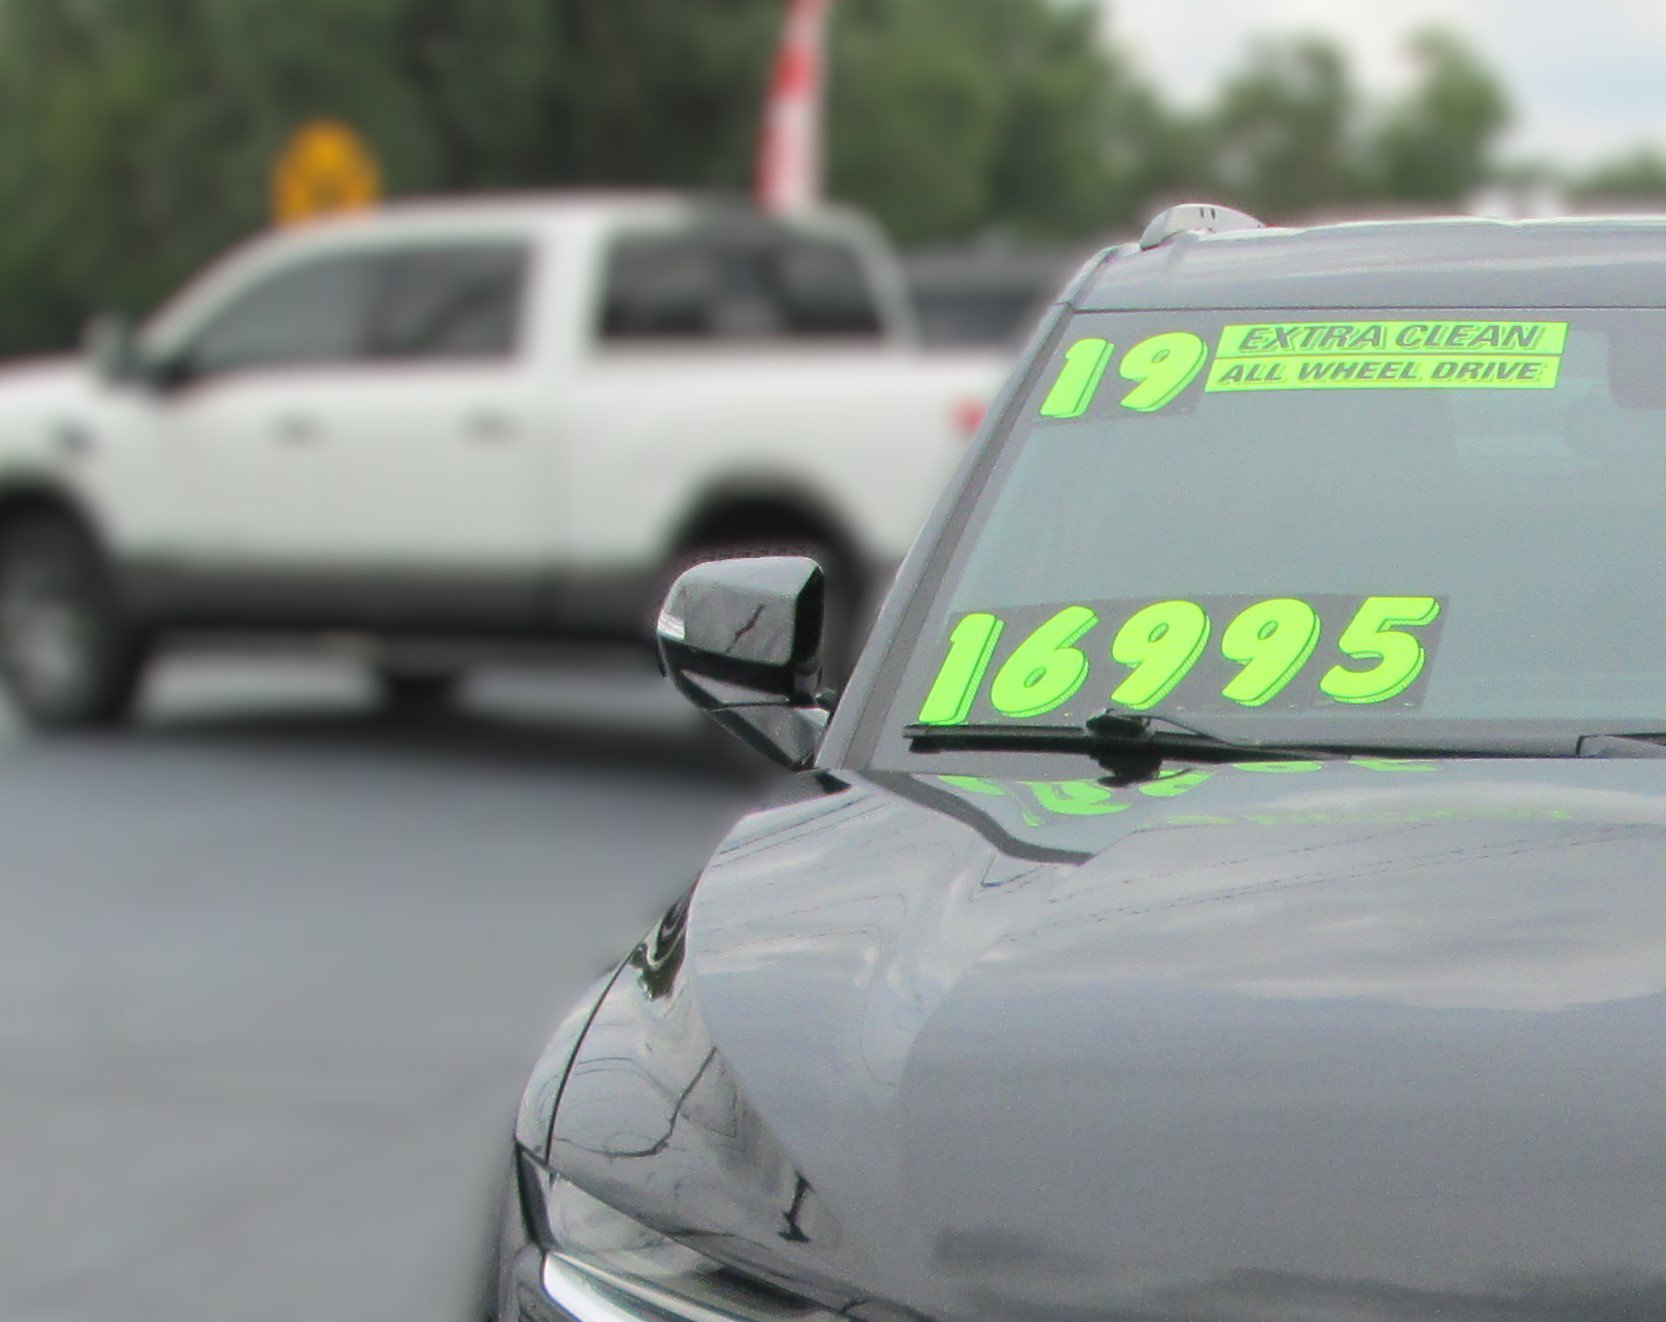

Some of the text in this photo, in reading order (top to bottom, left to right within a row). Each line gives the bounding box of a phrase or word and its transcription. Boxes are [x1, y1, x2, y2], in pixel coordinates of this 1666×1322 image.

[1237, 324, 1544, 352] EXTRA CLEAN
[1039, 331, 1208, 418] 19
[1216, 361, 1544, 385] ALL WHEEL DRIVE
[918, 596, 1440, 724] 16995
